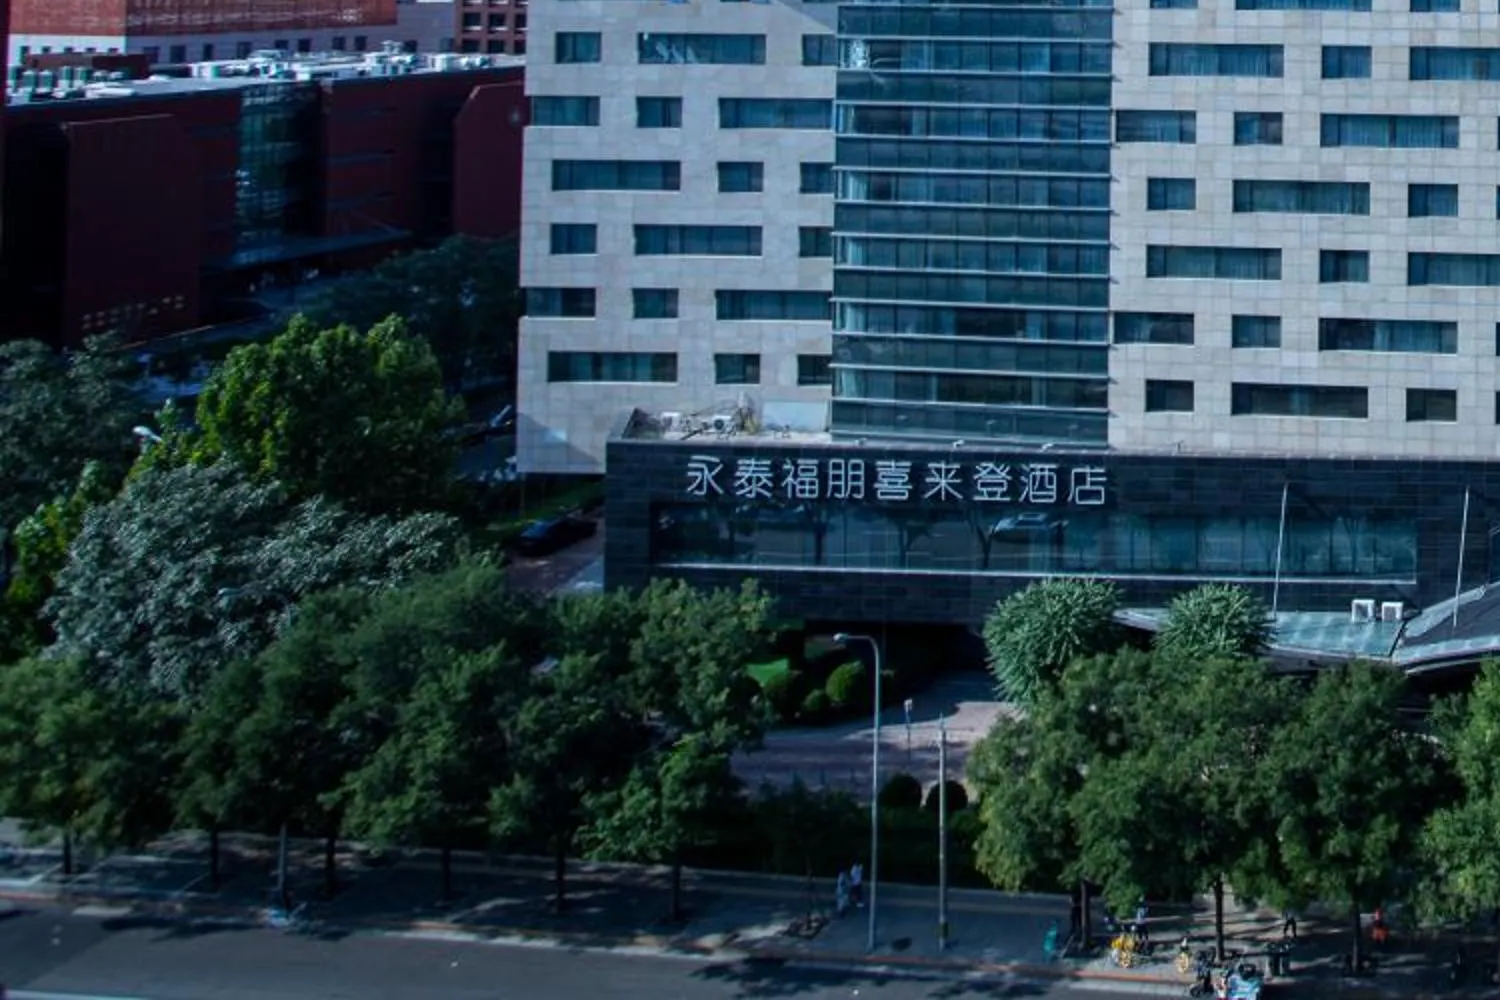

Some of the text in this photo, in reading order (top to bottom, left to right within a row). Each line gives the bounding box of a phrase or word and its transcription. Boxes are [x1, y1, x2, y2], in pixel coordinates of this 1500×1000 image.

[686, 455, 1108, 505] 永泰福朋喜来登酒店
